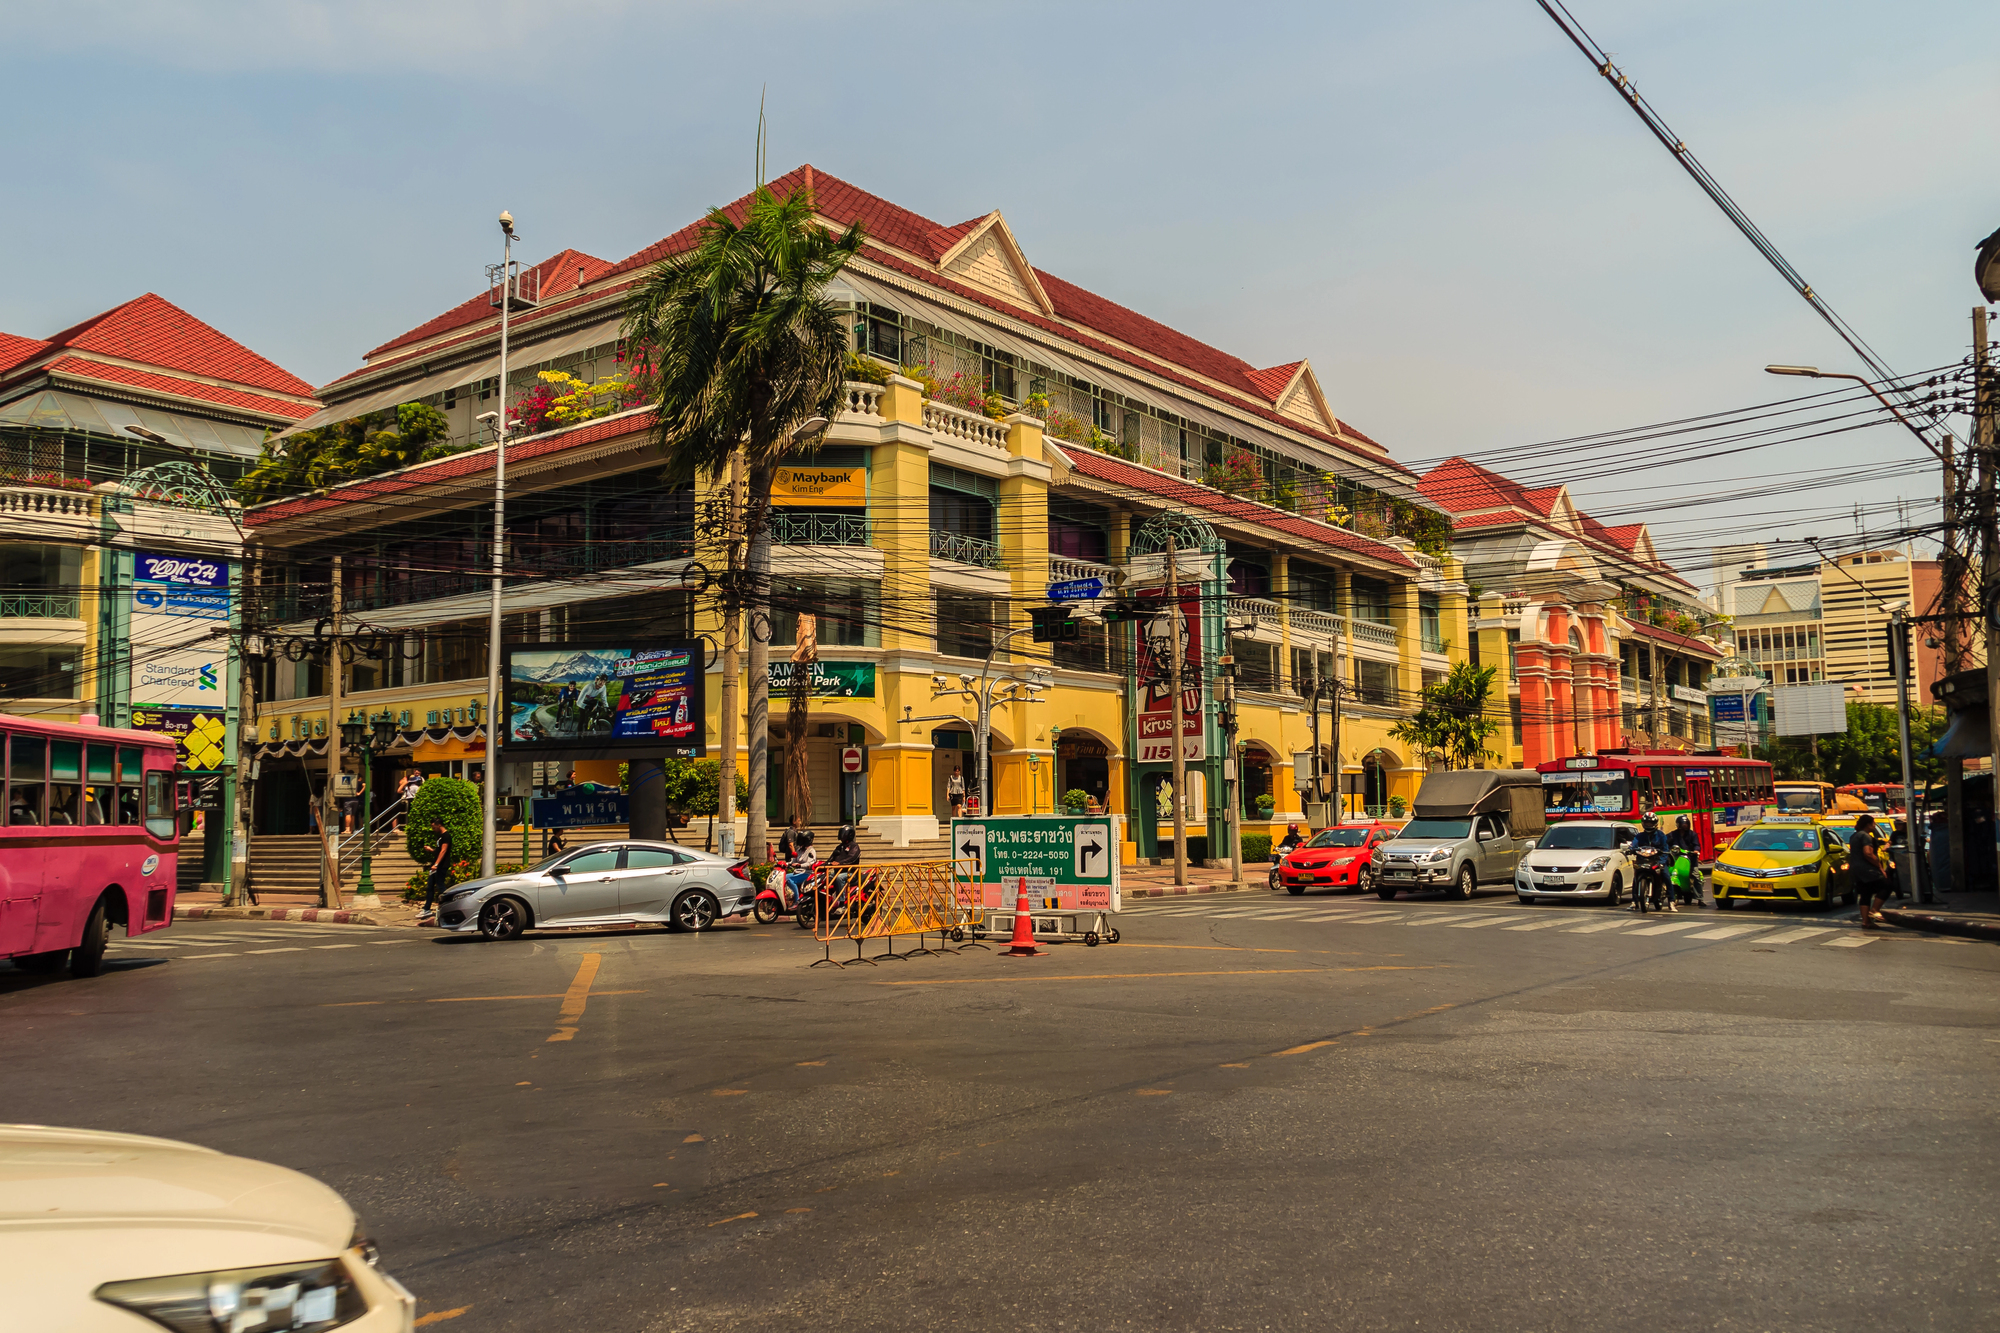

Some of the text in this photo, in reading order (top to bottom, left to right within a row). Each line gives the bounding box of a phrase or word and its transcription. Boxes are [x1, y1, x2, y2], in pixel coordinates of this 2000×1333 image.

[792, 472, 851, 485] Maybank
[792, 485, 824, 495] Kim Eng
[145, 663, 195, 676] Standard
[140, 675, 195, 687] Chartered
[819, 676, 841, 686] Park
[1142, 718, 1196, 736] krusers
[562, 798, 617, 818] พาหุรัด
[987, 825, 1073, 844] สน.พระราชวัง
[993, 847, 1069, 860] โทร. 0-2224-5050
[1049, 867, 1063, 876] 191
